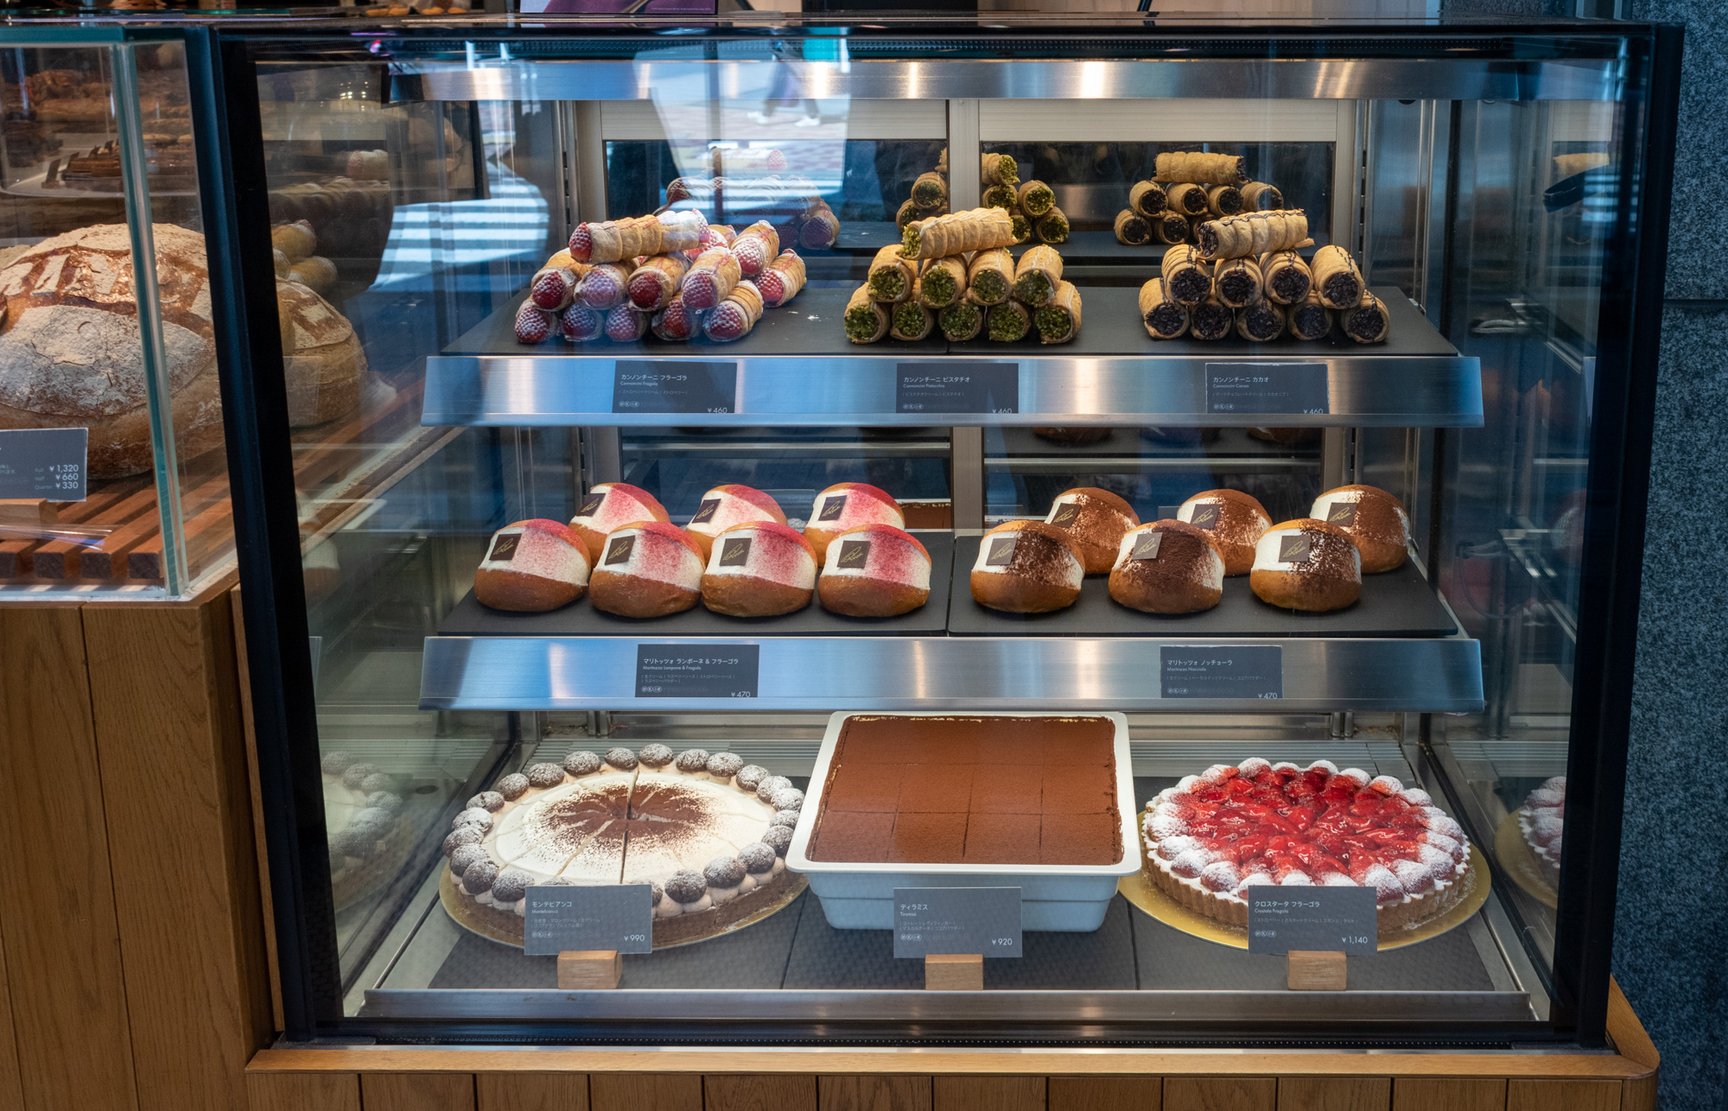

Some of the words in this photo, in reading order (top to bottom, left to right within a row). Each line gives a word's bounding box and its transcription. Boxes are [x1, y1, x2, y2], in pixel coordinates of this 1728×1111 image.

[900, 903, 929, 911] ティラミス
